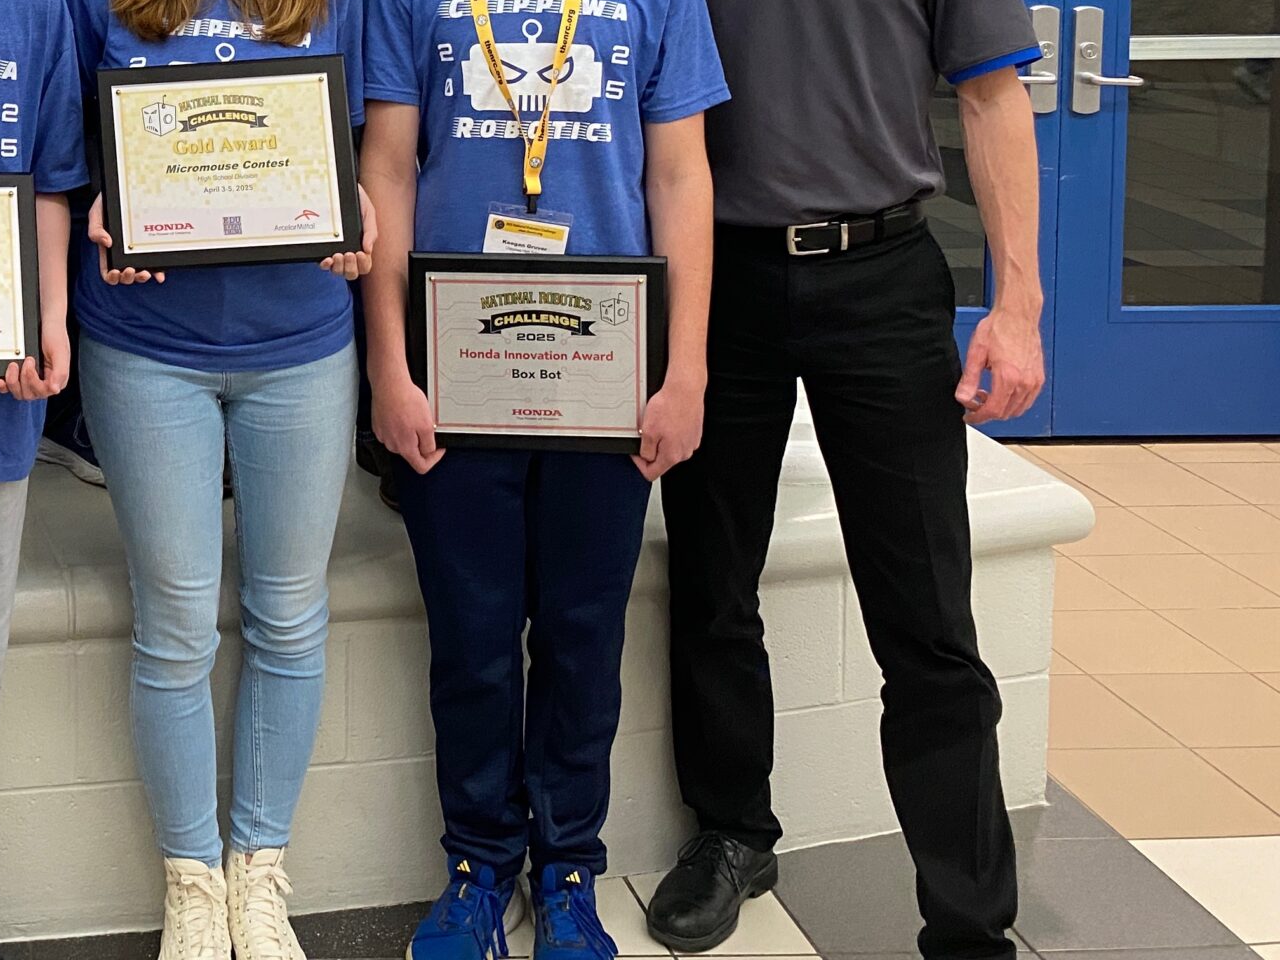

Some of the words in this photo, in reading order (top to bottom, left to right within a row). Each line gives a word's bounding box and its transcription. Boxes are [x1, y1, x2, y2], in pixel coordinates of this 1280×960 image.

[559, 9, 575, 53] thenrc.org
[437, 43, 454, 62] 2
[611, 45, 630, 65] 2
[484, 40, 503, 85] thenrc.org
[605, 80, 626, 100] 5
[178, 96, 221, 112] NATIONAL
[223, 94, 265, 107] ROBOTICS
[2, 103, 19, 123] 2
[190, 111, 256, 125] CHALLENGE
[0, 138, 17, 157] 5
[172, 138, 215, 155] Gold
[221, 135, 278, 153] Award
[166, 164, 239, 174] Micromouse
[242, 158, 290, 169] Contest
[203, 186, 220, 194] April
[236, 184, 254, 192] 2025
[144, 223, 194, 231] HONDA
[274, 222, 315, 232] ArcelorMittal
[480, 291, 536, 310] NATIONAL
[539, 291, 592, 311] ROBOTICS
[494, 313, 579, 328] CHALLENGE
[516, 333, 556, 342] 2025
[459, 348, 500, 359] Honda
[504, 350, 568, 361] Innovation
[572, 351, 614, 361] Award
[512, 369, 535, 379] Box
[540, 369, 562, 380] Bot
